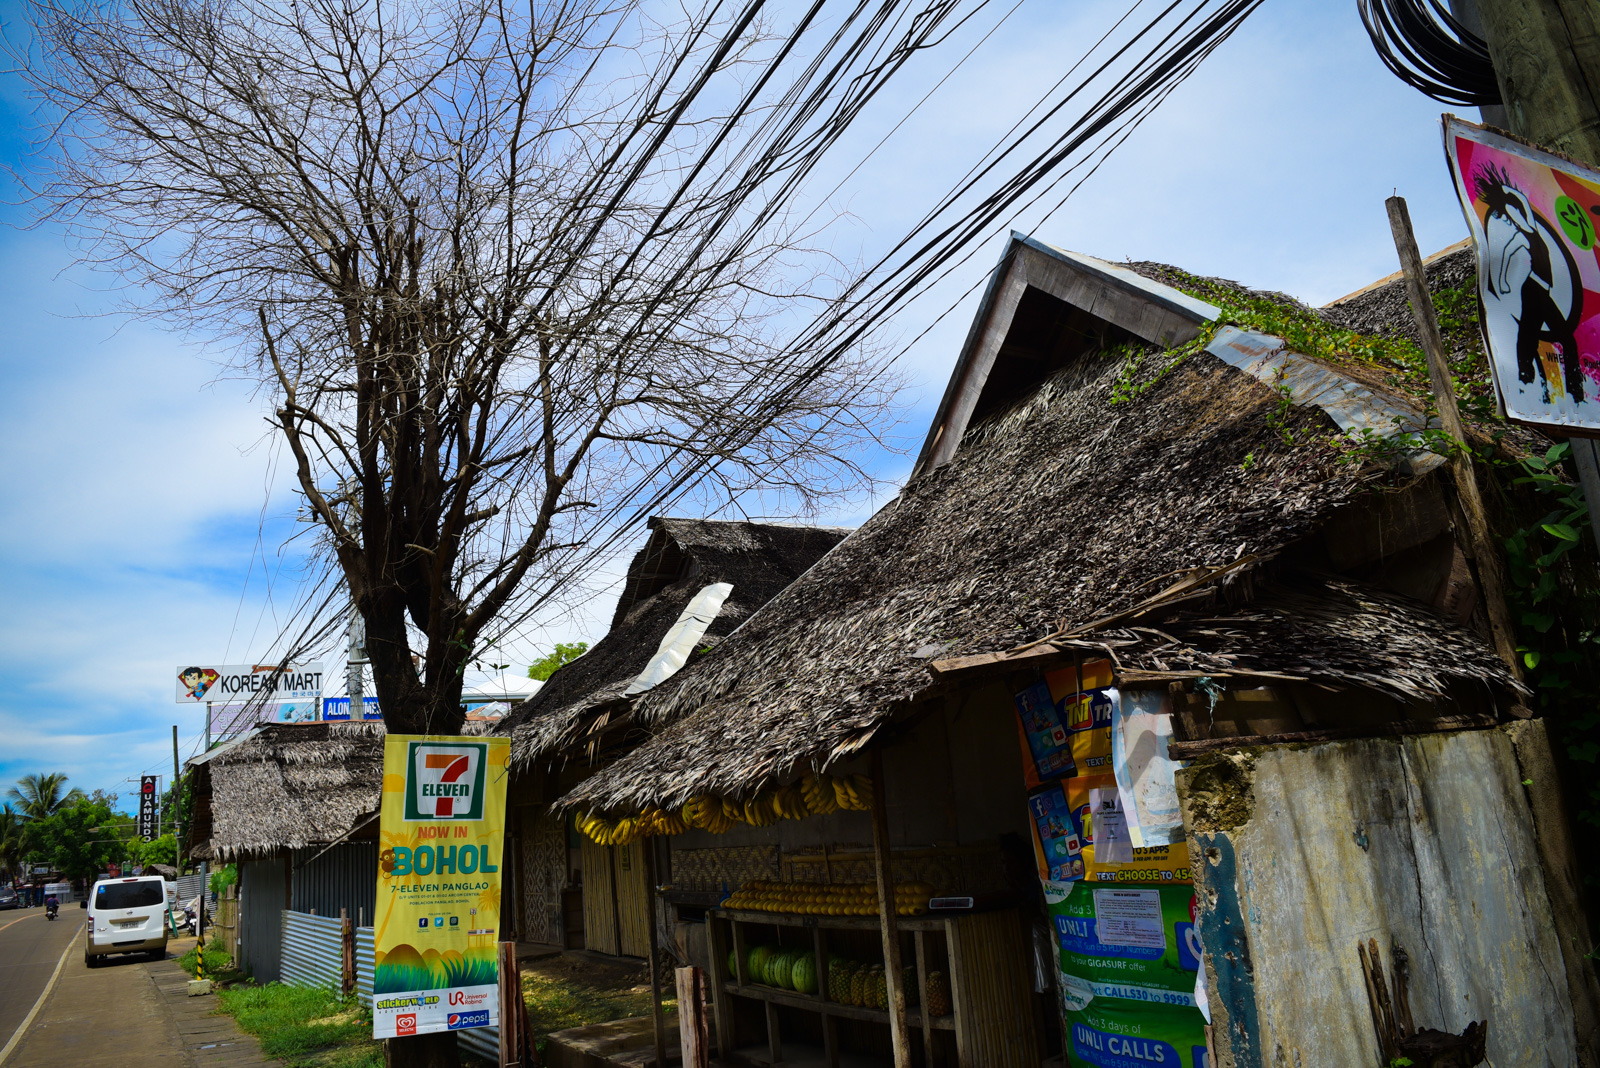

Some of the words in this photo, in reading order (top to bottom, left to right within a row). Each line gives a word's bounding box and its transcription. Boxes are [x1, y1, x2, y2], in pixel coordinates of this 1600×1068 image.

[221, 674, 279, 694] KOREAN
[284, 672, 322, 691] MART
[327, 701, 351, 716] ALON
[1065, 695, 1093, 730] TNT
[1094, 703, 1113, 722] TR
[1085, 757, 1104, 767] TEXT
[425, 753, 469, 817] 7
[143, 776, 154, 843] AQUAMUNDO
[418, 826, 450, 839] NOW
[454, 826, 468, 838] IN
[1149, 845, 1170, 854] APPS
[391, 844, 498, 876] BOHOL
[1096, 872, 1116, 881] TEXT
[1117, 869, 1160, 881] CHOOSE
[1160, 871, 1173, 880] TO
[1174, 868, 1193, 880] 454
[391, 884, 440, 893] 7-ELEVEN
[442, 882, 489, 891] PANGLAO
[1049, 885, 1066, 896] Smart
[1069, 904, 1084, 915] Add
[1086, 905, 1092, 915] 3
[1058, 917, 1089, 938] UNLI
[1087, 956, 1127, 970] GIGASURF
[1128, 963, 1146, 972] offer
[1104, 986, 1148, 1001] CALLS30
[1150, 993, 1161, 1003] to
[1163, 993, 1191, 1006] 9999
[462, 1012, 488, 1025] pepsi
[1087, 1015, 1100, 1027] Add
[1100, 1018, 1106, 1029] 3
[1108, 1020, 1129, 1034] days
[1131, 1024, 1142, 1034] of
[1077, 1026, 1104, 1052] UNLI
[1108, 1037, 1165, 1063] CALLS
